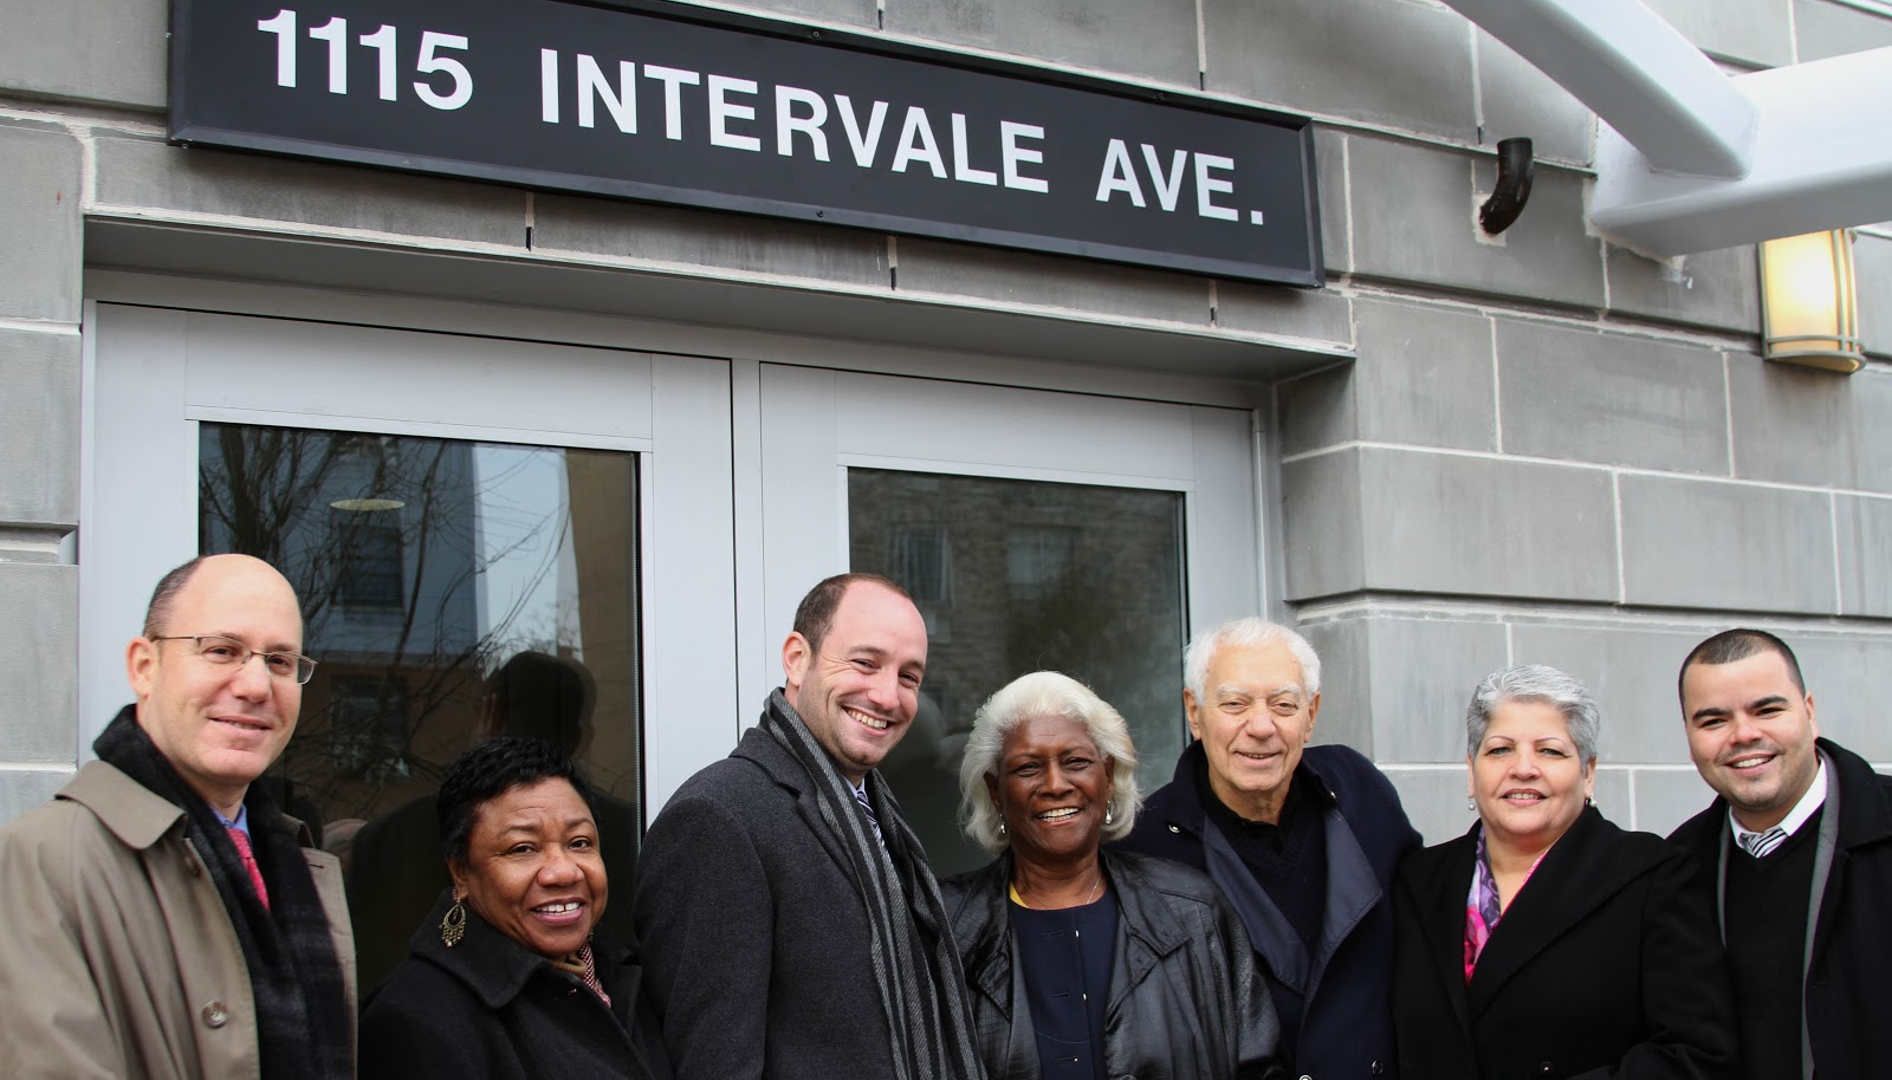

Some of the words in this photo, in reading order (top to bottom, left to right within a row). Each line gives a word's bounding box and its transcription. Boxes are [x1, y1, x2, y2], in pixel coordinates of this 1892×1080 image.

[256, 9, 473, 110] 1115
[540, 48, 1049, 193] INTERVALE
[1095, 138, 1265, 225] AVE.
